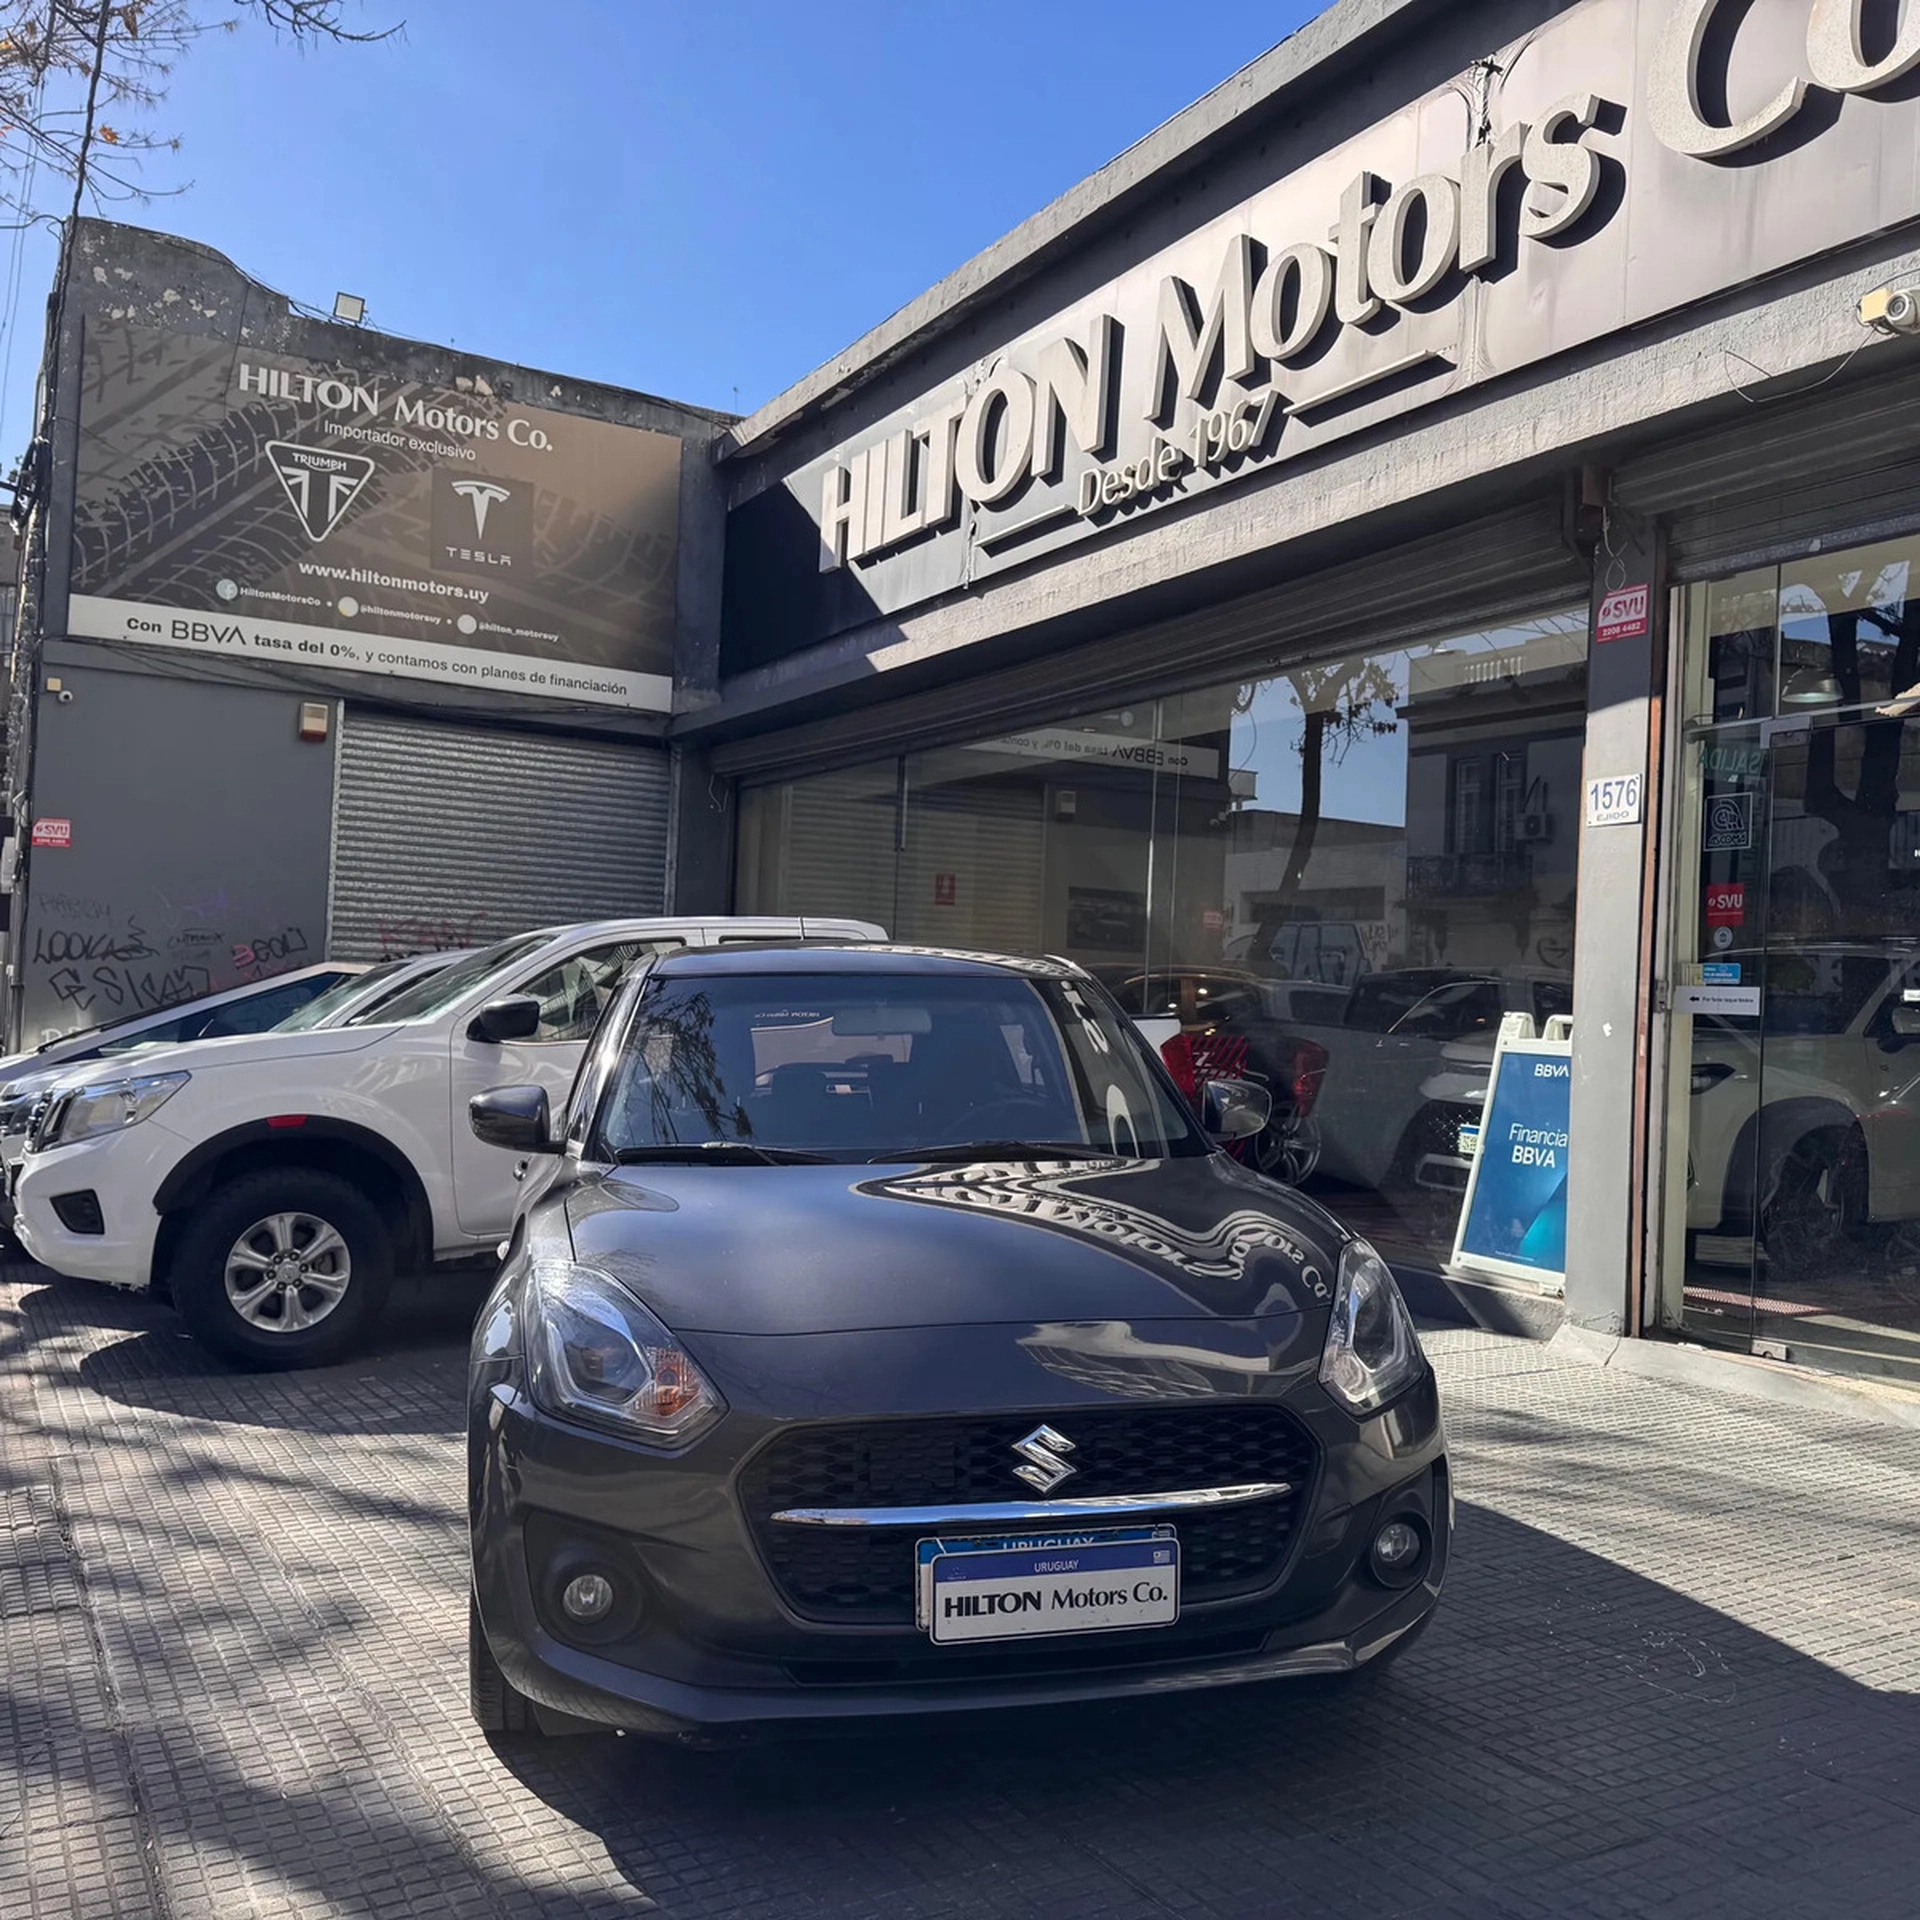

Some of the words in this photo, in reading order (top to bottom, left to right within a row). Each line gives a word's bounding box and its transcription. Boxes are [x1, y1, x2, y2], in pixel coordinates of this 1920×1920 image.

[819, 314, 1113, 573] HILTON
[1144, 94, 1602, 421] Motors
[239, 363, 379, 416] HILTON
[394, 395, 500, 441] Motors
[507, 419, 553, 451] Co.
[324, 420, 406, 449] Importador
[409, 436, 476, 461] exclusivo
[292, 452, 347, 471] TRIUMPH
[1078, 437, 1182, 516] Desde
[1189, 390, 1278, 467] 1967
[445, 546, 512, 566] TESLA
[299, 562, 490, 604] www.hiltonmotors.uy
[1613, 596, 1644, 618] SVU
[127, 617, 162, 633] Con
[171, 619, 247, 646] BBVA
[254, 634, 293, 651] tasa
[298, 639, 325, 655] del
[365, 650, 375, 663] y
[378, 651, 448, 672] contamos
[452, 661, 478, 675] con
[481, 665, 526, 682] planes
[529, 671, 546, 684] de
[549, 673, 628, 696] financiación
[1590, 778, 1637, 811] 1576
[1596, 811, 1630, 822] EJIDO
[44, 825, 68, 836] SVU
[1717, 894, 1743, 909] SVU
[1534, 1063, 1570, 1078] BBVA
[1509, 1123, 1568, 1148] Financia
[1512, 1146, 1556, 1168] BBVA
[1034, 1560, 1079, 1573] URUGUAY
[944, 1591, 1042, 1618] HILTON
[1051, 1586, 1128, 1610] Motors
[1132, 1581, 1169, 1603] Co.
